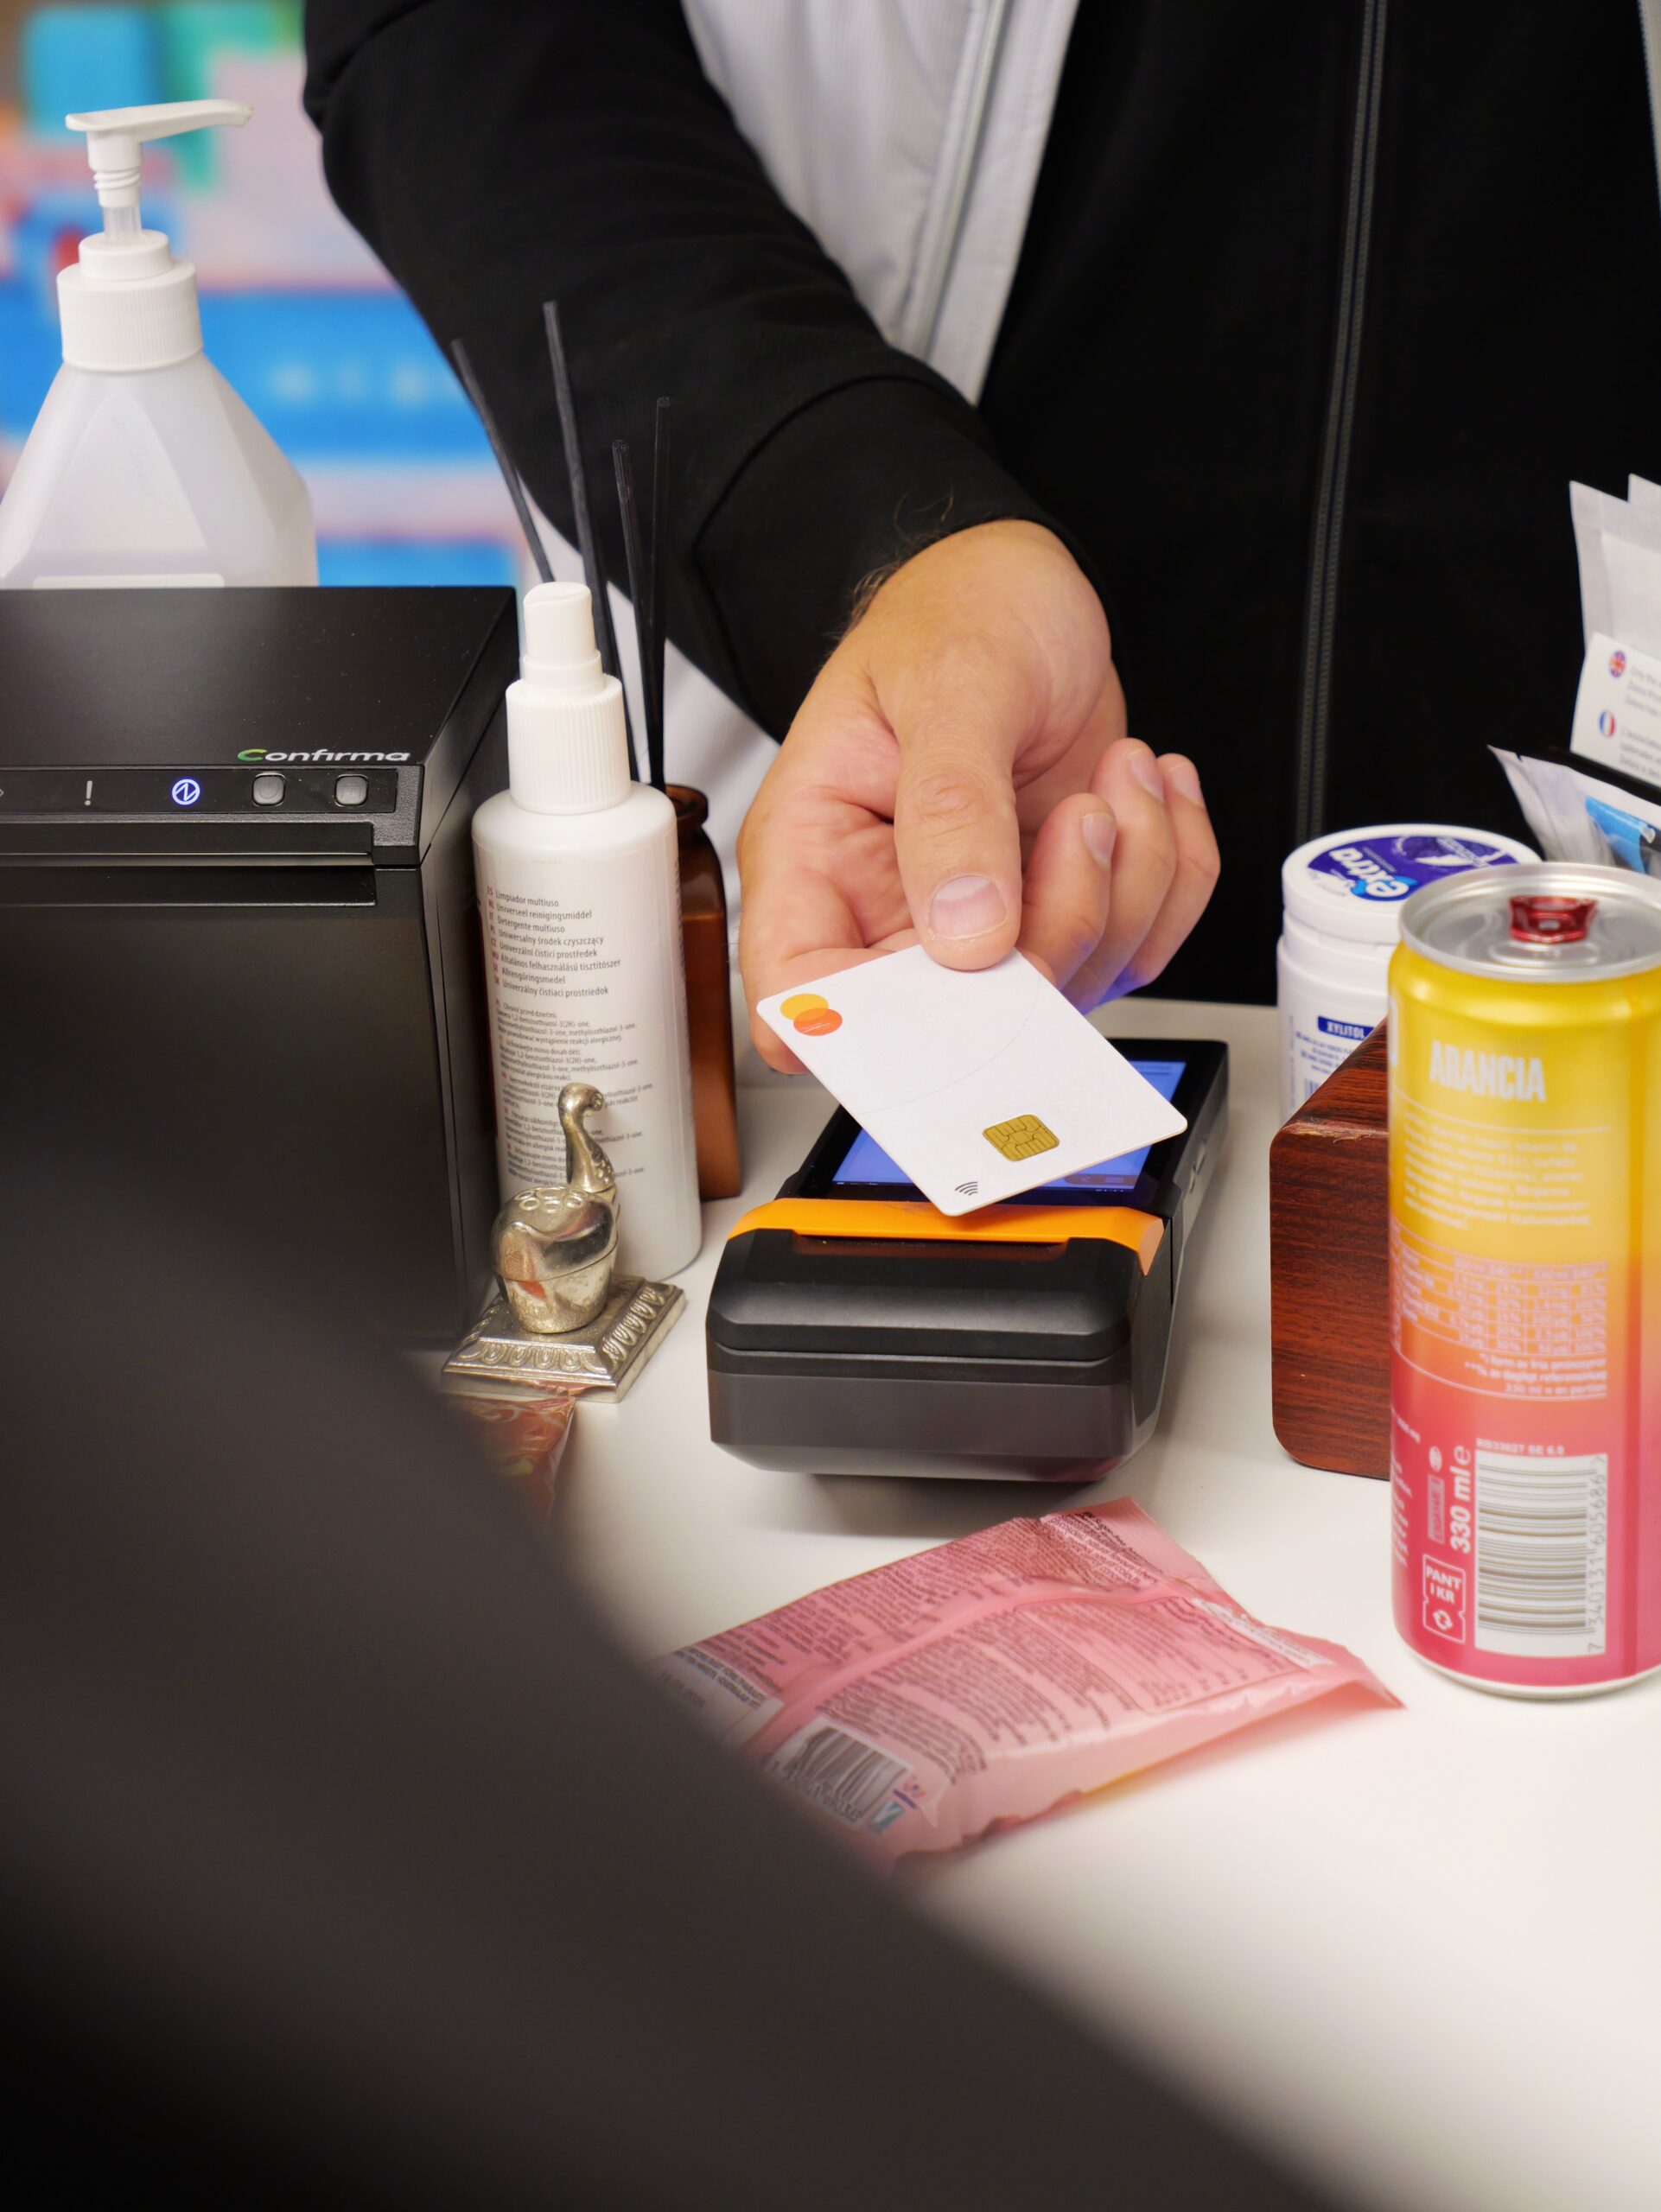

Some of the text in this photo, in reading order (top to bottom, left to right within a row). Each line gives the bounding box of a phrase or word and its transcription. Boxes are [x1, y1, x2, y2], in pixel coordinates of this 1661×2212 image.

[237, 748, 411, 762] Confirma
[495, 890, 525, 905] Limpiador
[527, 898, 559, 907] multiuso
[497, 903, 527, 918] Universeel
[530, 910, 592, 922] reinigingsmiddel
[497, 916, 531, 931] Detergente
[533, 923, 565, 933] multiuso
[499, 929, 536, 945] Uniwersalny
[538, 935, 562, 946] środek
[563, 936, 604, 947] czyszczący
[501, 953, 528, 969] Általános
[529, 961, 578, 972] felhasználású
[580, 959, 621, 971] tisztítószer
[557, 949, 597, 959] prostředek
[502, 967, 565, 984] Allrengöringsmedel
[502, 981, 538, 996] Univerzálny
[565, 985, 609, 998] prostriedok
[1327, 1020, 1365, 1039] XYLITOL
[1430, 1039, 1546, 1102] ARANCIA
[1450, 1505, 1471, 1554] 330
[1426, 1566, 1462, 1590] PANT
[1436, 1586, 1455, 1604] KR
